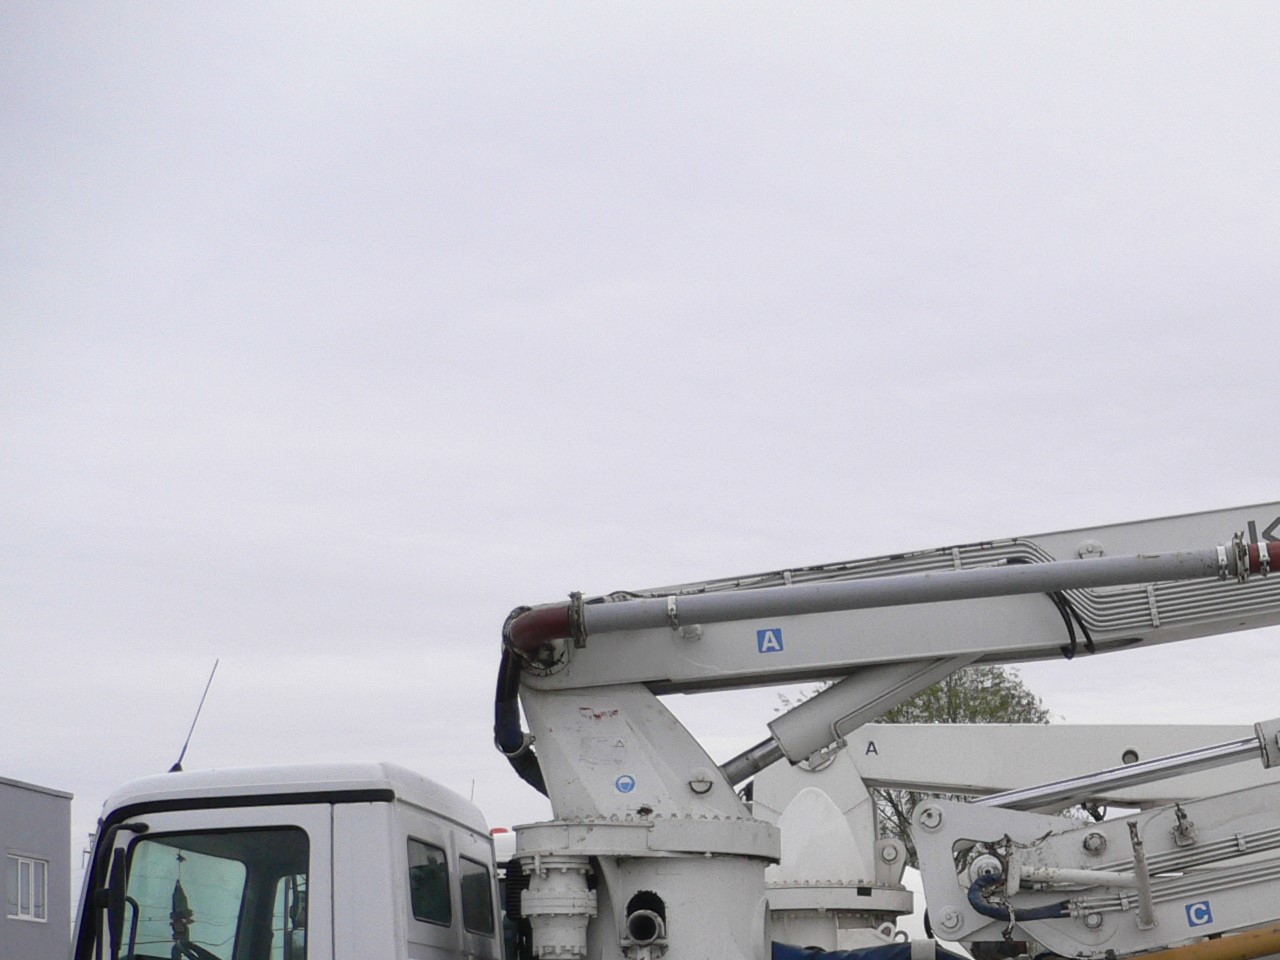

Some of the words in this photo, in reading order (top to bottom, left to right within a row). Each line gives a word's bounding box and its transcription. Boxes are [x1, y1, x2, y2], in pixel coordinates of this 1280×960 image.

[761, 630, 781, 652] A
[865, 740, 879, 756] A
[1190, 903, 1209, 925] C
